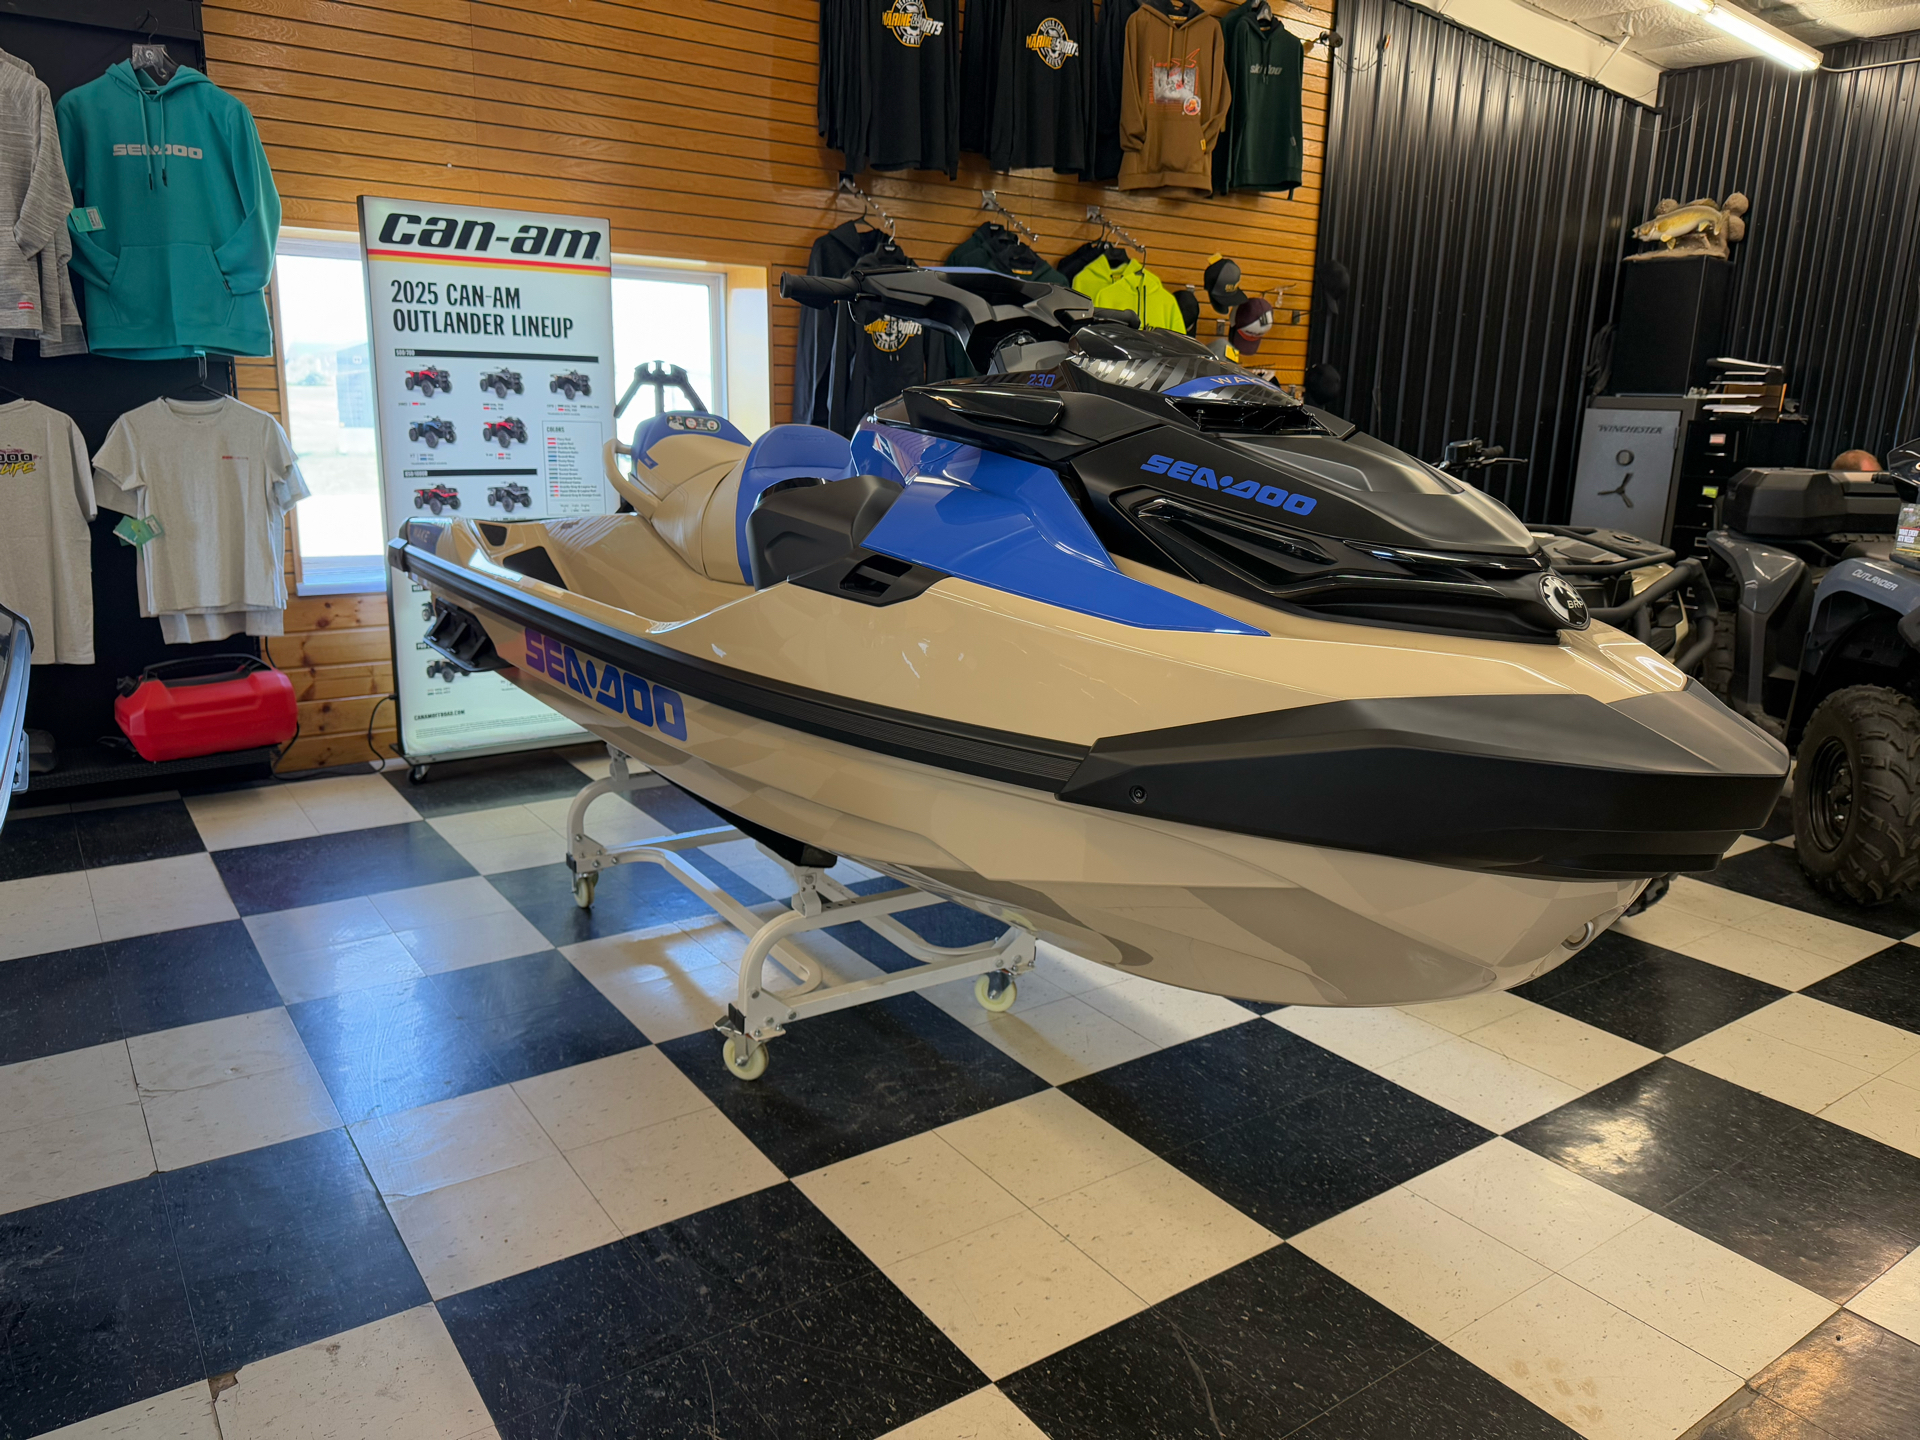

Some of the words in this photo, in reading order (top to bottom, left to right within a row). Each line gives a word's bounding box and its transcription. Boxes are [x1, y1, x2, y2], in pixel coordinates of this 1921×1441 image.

[391, 280, 439, 305] 2025
[446, 283, 521, 309] CAN-AM
[393, 309, 505, 336] OUTLANDER
[511, 314, 574, 338] LINEUP
[1027, 373, 1057, 388] 230
[1598, 424, 1663, 435] WINCHESTER
[0, 461, 36, 478] LIFE
[1852, 569, 1899, 591] OUTLANDER
[1567, 600, 1585, 609] BRP
